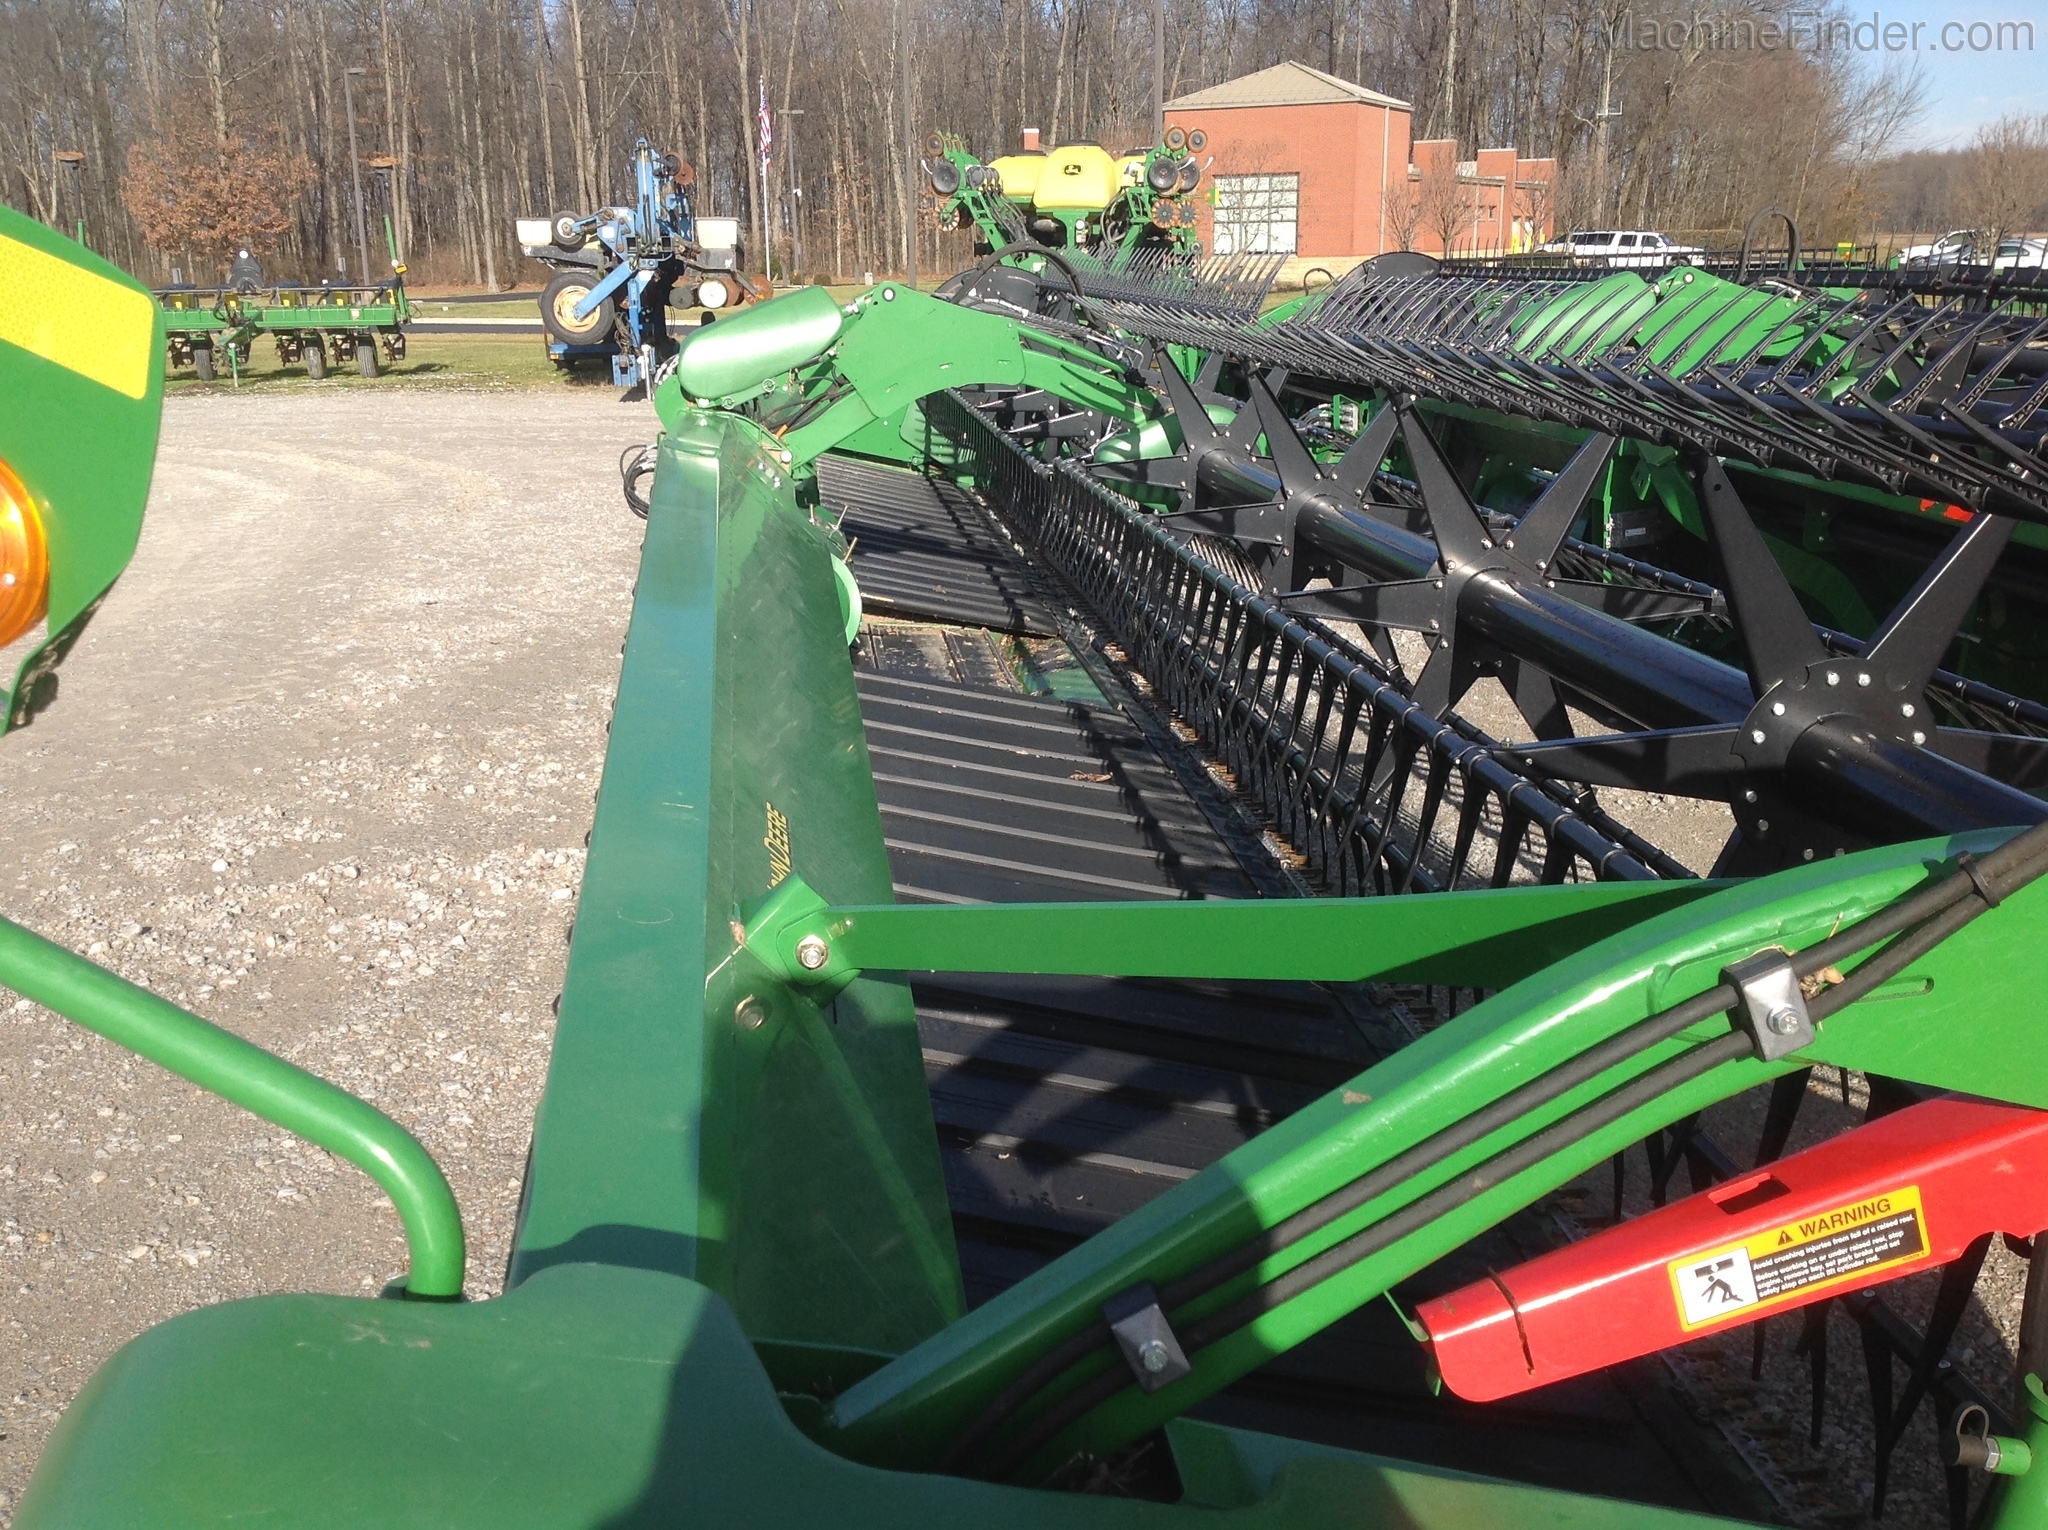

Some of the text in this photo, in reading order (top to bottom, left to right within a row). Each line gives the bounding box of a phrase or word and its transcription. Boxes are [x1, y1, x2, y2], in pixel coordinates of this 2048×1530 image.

[763, 801, 791, 867] DEERE
[1753, 1257, 1773, 1270] Avoid
[1774, 1247, 1805, 1265] crushing
[1833, 1234, 1849, 1245] from
[1850, 1229, 1861, 1239] fall
[1862, 1227, 1870, 1235] of
[1877, 1218, 1898, 1231] raised
[1899, 1213, 1914, 1224] reel.
[1799, 1198, 1891, 1237] WARNING
[1756, 1268, 1778, 1281] Before
[1779, 1259, 1807, 1275] working
[1808, 1257, 1818, 1265] on
[1828, 1246, 1848, 1258] under
[1849, 1239, 1871, 1251] raised
[1888, 1229, 1904, 1241] stop
[1759, 1285, 1780, 1298] safety
[1781, 1280, 1797, 1291] stop
[1798, 1277, 1807, 1285] on
[1808, 1271, 1825, 1281] each
[1837, 1258, 1865, 1274] cylinder
[1866, 1253, 1880, 1264] rod.
[1784, 1268, 1809, 1281] remove
[1825, 1259, 1836, 1268] set
[1837, 1253, 1853, 1265] park
[1854, 1247, 1873, 1258] brake
[1875, 1242, 1888, 1252] and
[1889, 1239, 1900, 1248] set
